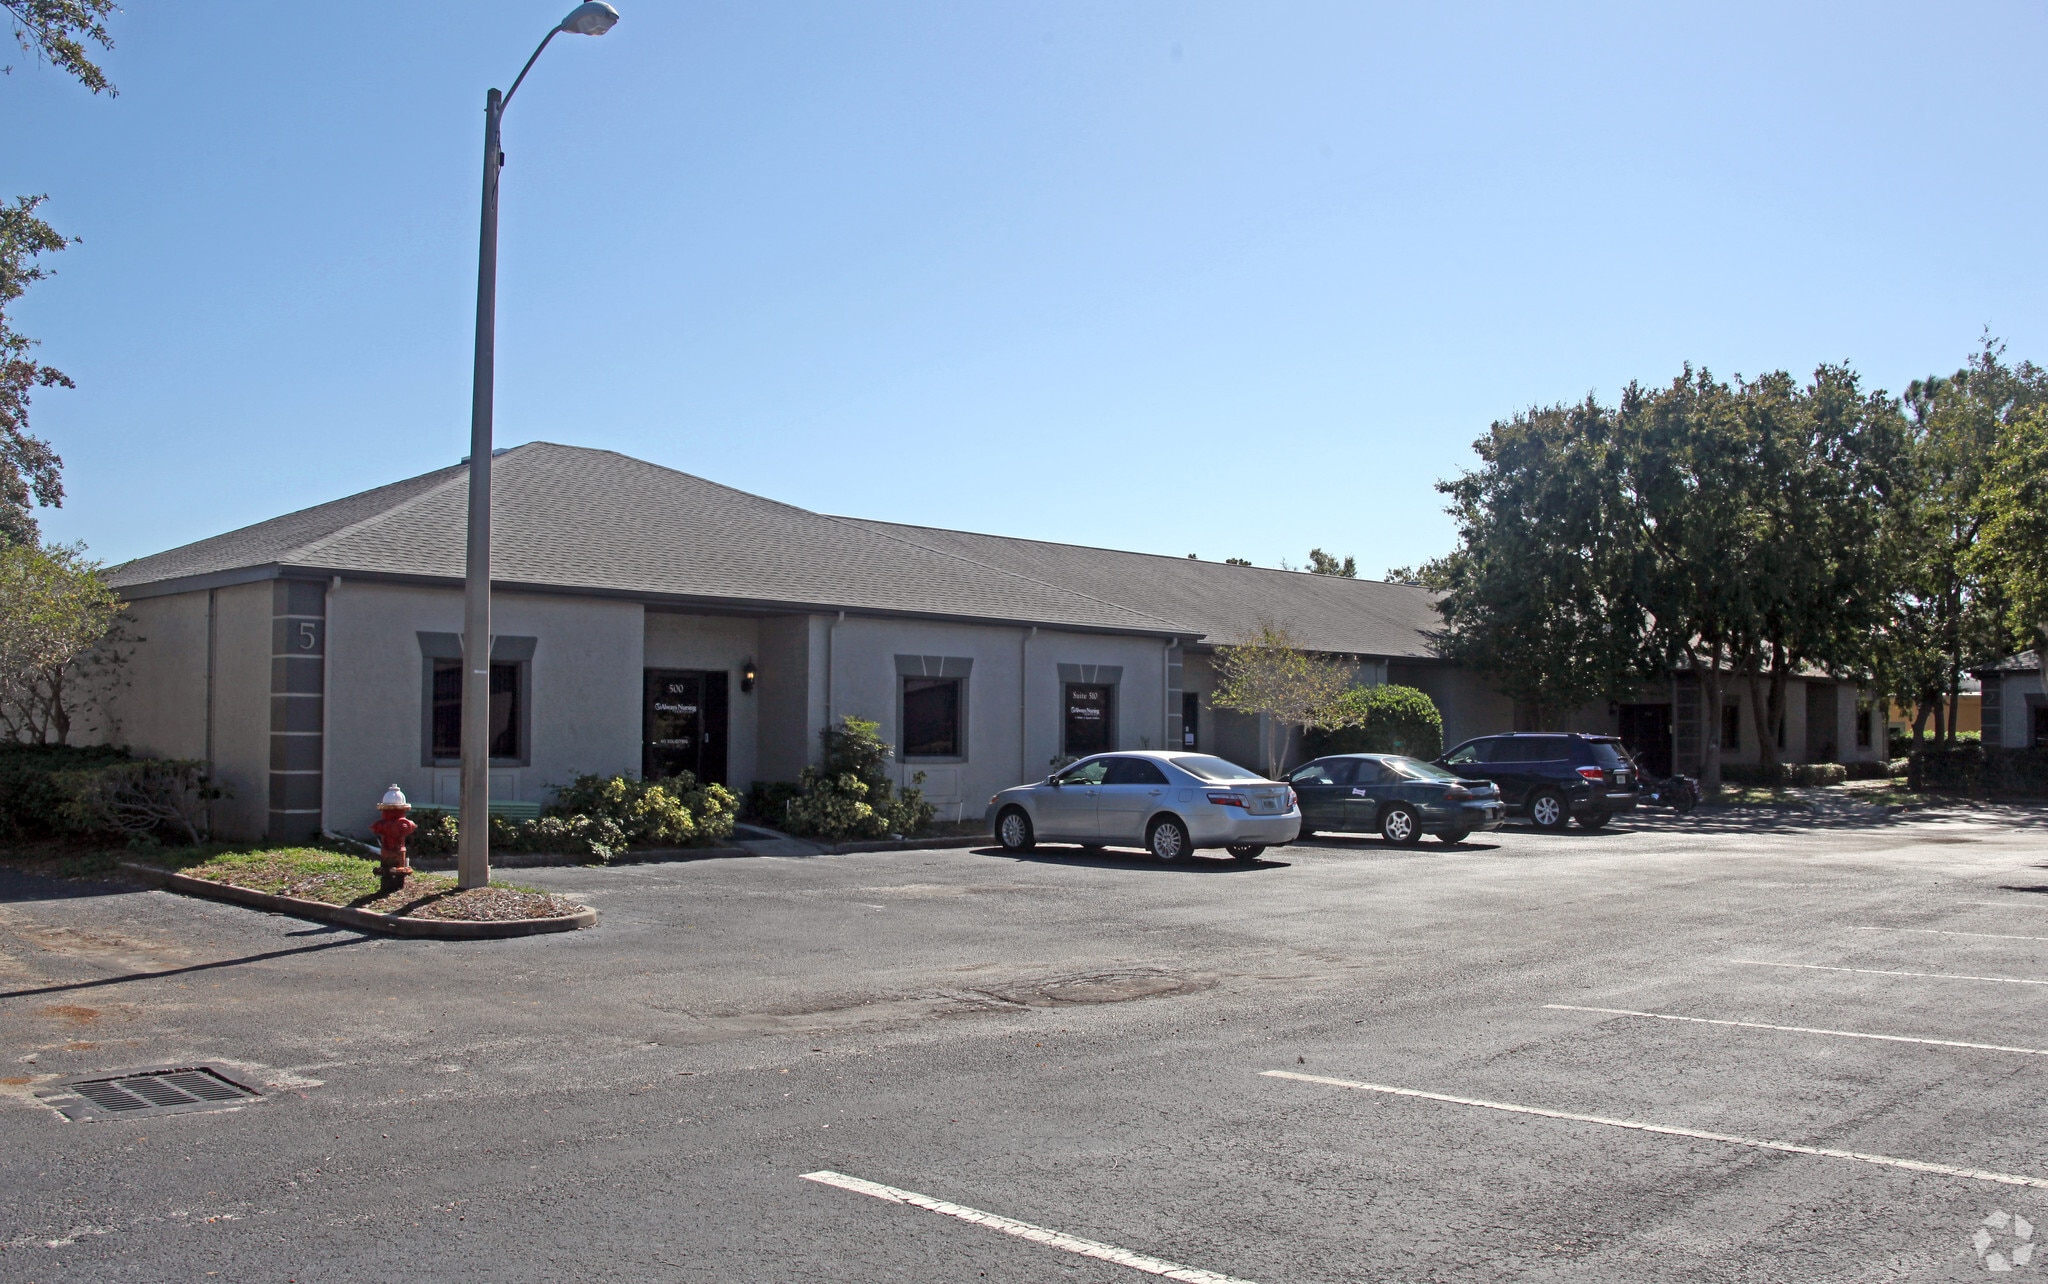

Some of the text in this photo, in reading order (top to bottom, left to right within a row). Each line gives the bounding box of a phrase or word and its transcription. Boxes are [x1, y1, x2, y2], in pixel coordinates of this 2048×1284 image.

[300, 622, 315, 650] 5
[669, 684, 684, 693] 500
[1072, 691, 1087, 699] Suite
[677, 703, 696, 712] Nursing
